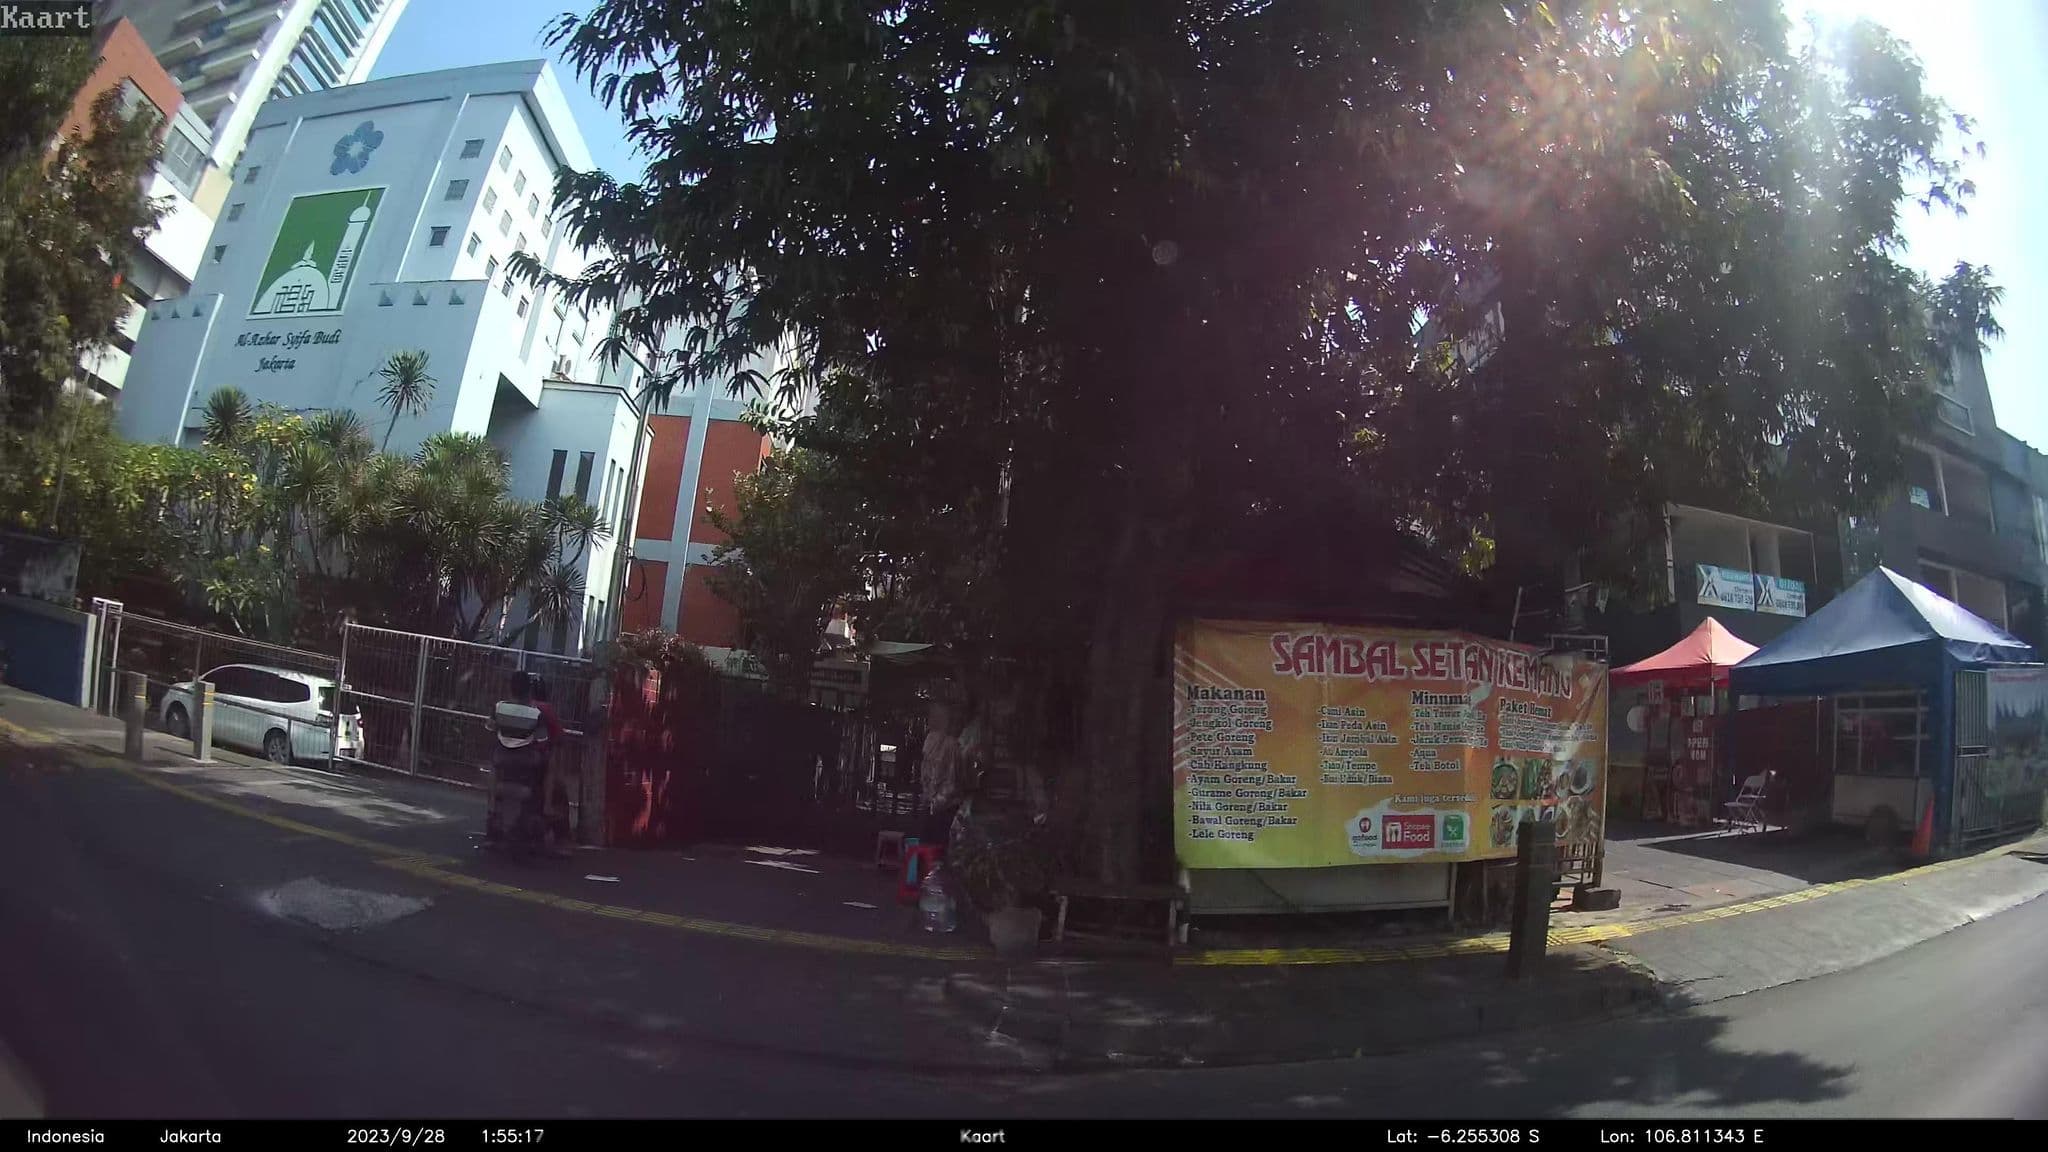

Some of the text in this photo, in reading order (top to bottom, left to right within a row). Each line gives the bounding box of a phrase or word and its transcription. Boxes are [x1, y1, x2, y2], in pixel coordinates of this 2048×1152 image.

[312, 329, 342, 344] Budi
[254, 355, 296, 373] Jakarta
[1271, 633, 1406, 681] SAMBAL
[1411, 639, 1493, 683] SETAN
[1187, 686, 1265, 700] Makanan
[1411, 691, 1472, 704] Minuma
[1229, 704, 1268, 716] Goreng
[1500, 698, 1527, 714] Paket
[1235, 719, 1272, 731] Goreng
[1217, 732, 1255, 744] Goreng
[1434, 760, 1460, 770] Botol
[1217, 829, 1254, 841] Goreng
[1403, 831, 1430, 842] Food
